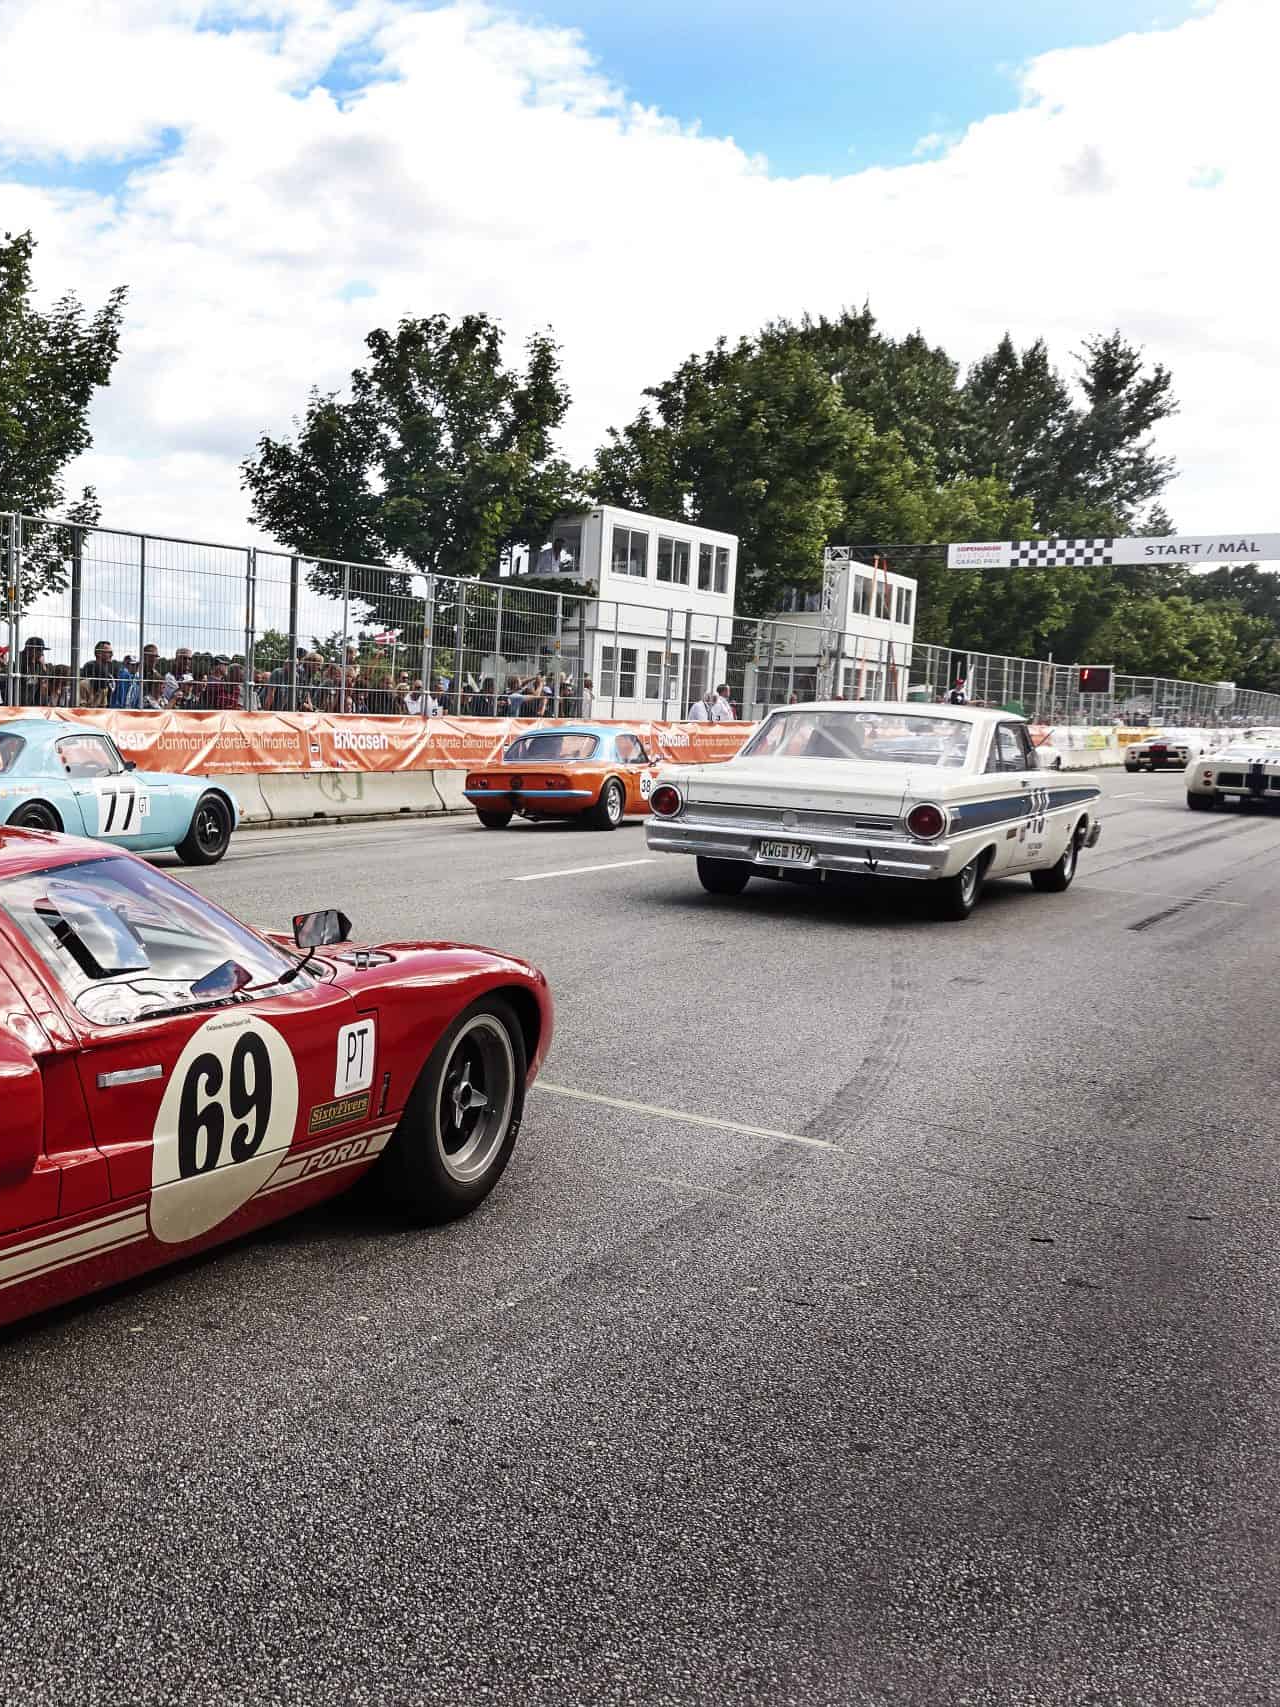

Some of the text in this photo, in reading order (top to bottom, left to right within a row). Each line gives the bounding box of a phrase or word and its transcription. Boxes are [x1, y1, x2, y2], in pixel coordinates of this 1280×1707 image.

[1145, 544, 1201, 555] START
[1218, 540, 1261, 552] MÅL
[253, 734, 300, 750] bilmarked
[641, 779, 651, 793] 38
[102, 789, 135, 832] 77
[761, 842, 810, 861] XWG 197
[346, 1029, 368, 1082] PT
[177, 1031, 272, 1180] 69
[312, 1097, 369, 1122] SixtyFivers
[302, 1139, 368, 1175] FORD
